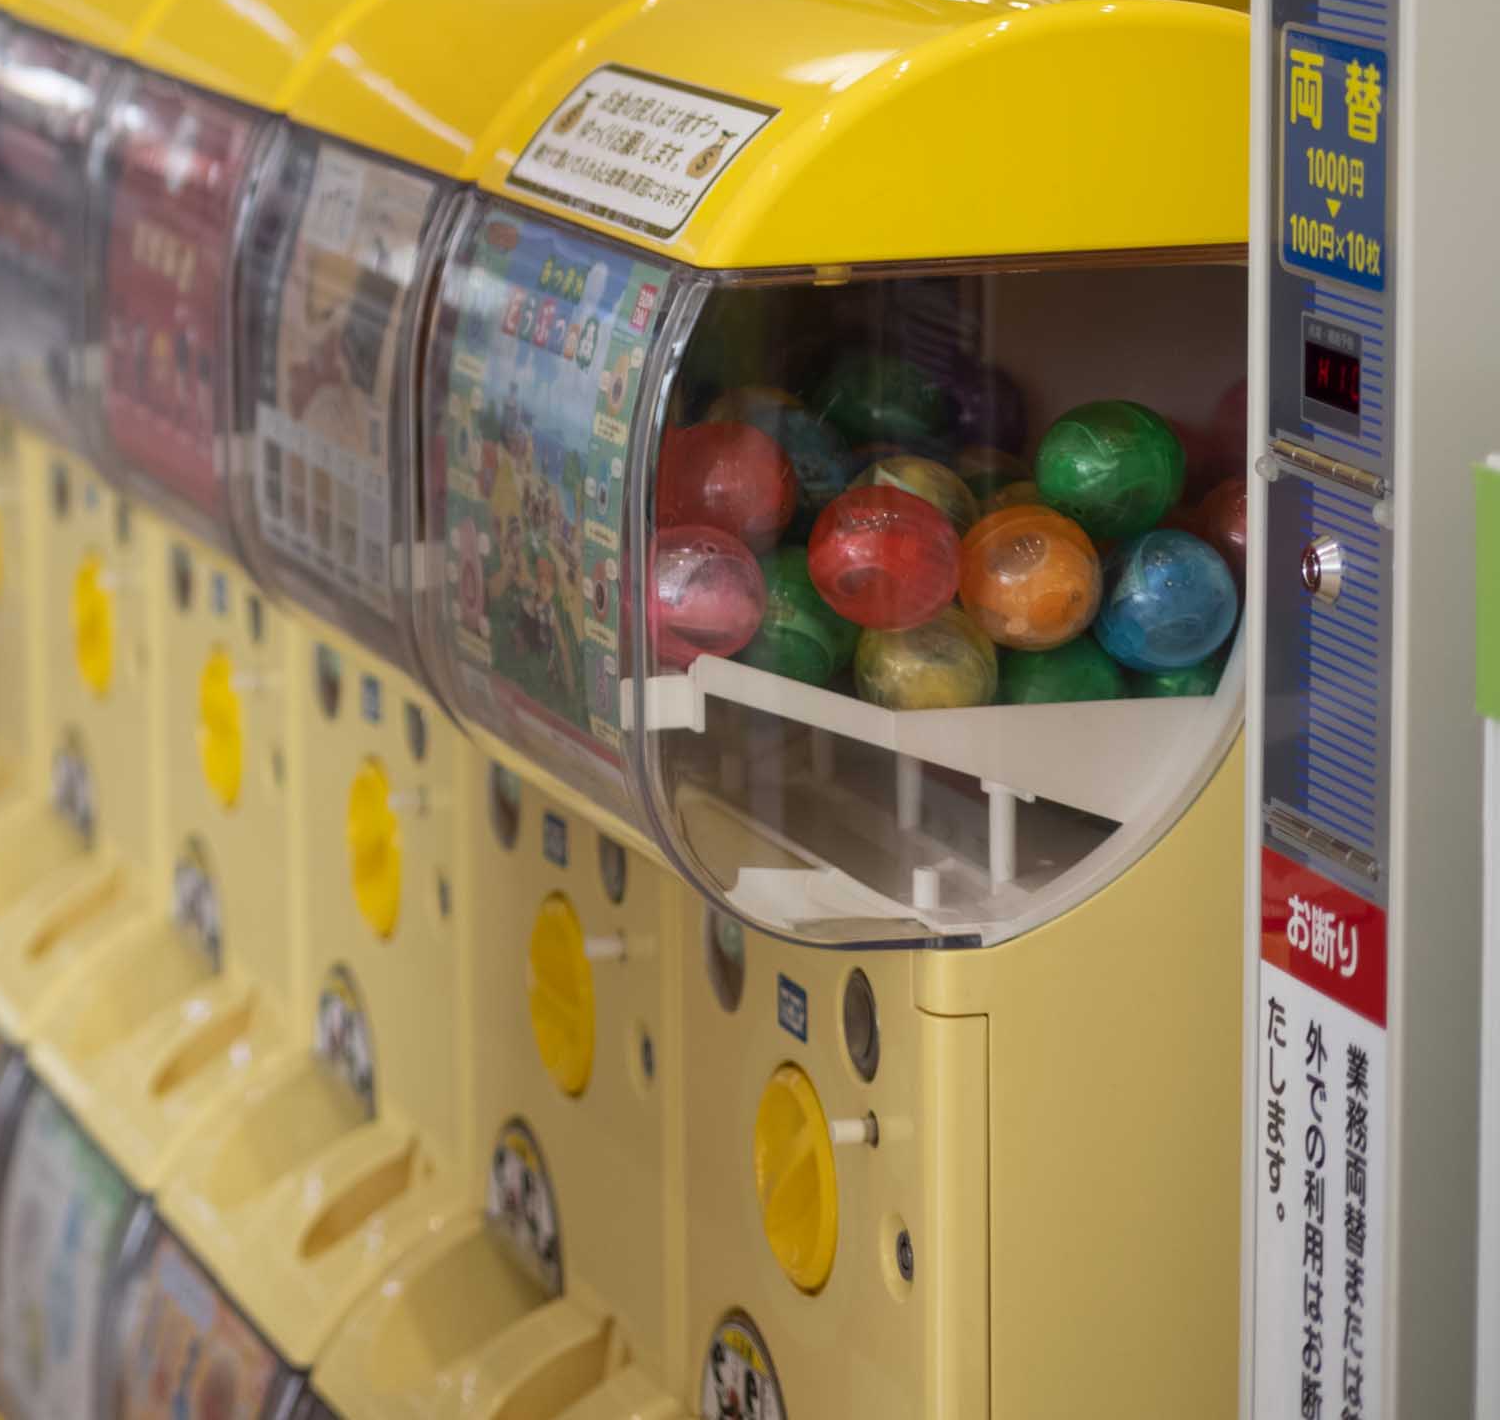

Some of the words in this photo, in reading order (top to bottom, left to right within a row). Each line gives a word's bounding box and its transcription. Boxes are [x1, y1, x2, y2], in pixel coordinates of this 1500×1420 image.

[1290, 48, 1383, 144] 両替
[1306, 147, 1365, 200] 1000円
[1290, 212, 1381, 277] 100円×10枚
[1286, 893, 1360, 978] お断り
[1266, 996, 1288, 1223] たします。
